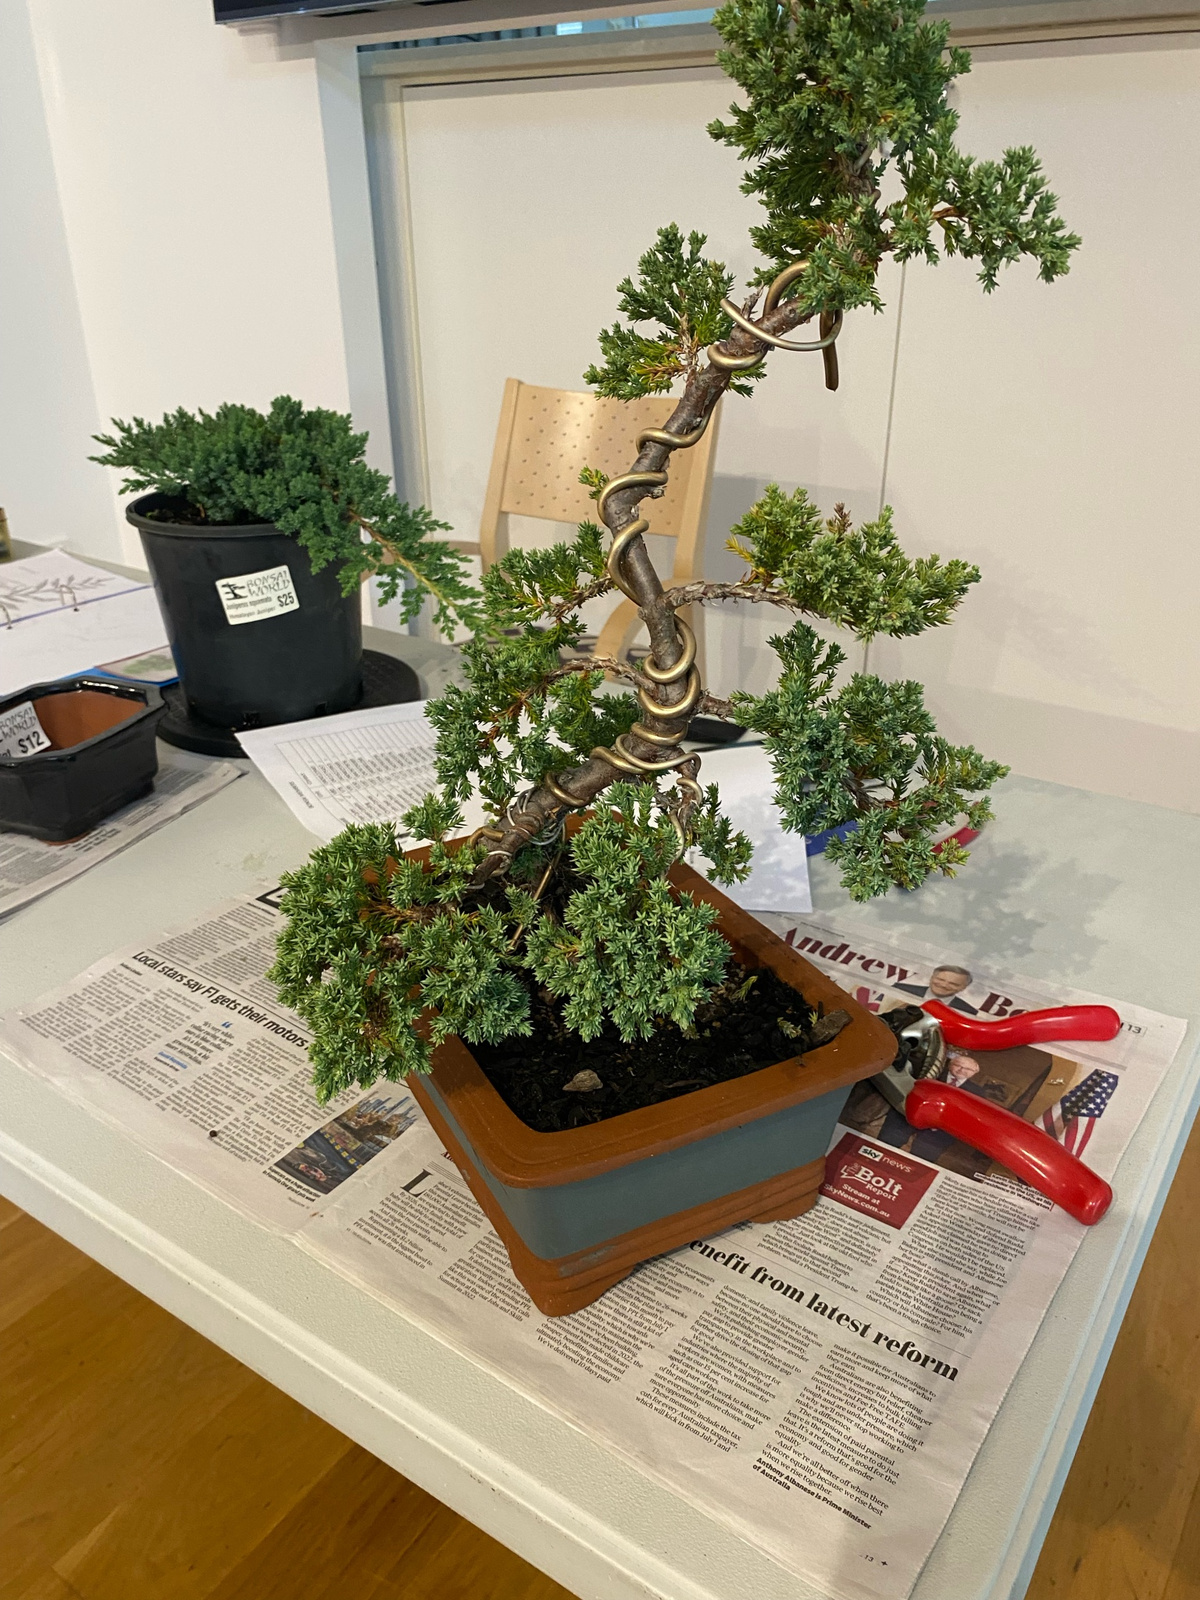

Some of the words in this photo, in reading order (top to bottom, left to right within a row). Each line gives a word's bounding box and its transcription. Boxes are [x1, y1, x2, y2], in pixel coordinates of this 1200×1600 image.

[247, 571, 287, 587] BONSAI
[248, 579, 290, 596] WORLD
[277, 592, 294, 607] $25
[1, 716, 36, 738] WORLD
[785, 927, 919, 982] Andrew
[132, 949, 165, 970] Local
[158, 964, 187, 983] stars
[182, 977, 205, 994] say
[200, 983, 220, 999] F1
[212, 993, 240, 1011] gets
[237, 1003, 266, 1025] their
[262, 1018, 308, 1049] motors
[1128, 1024, 1142, 1034] 13
[862, 1148, 880, 1158] sky
[882, 1158, 912, 1172] news
[842, 1184, 870, 1200] Stream
[855, 1166, 902, 1196] Bolt
[866, 1184, 896, 1201] Report
[824, 1184, 890, 1217] SkyNews.com.au
[687, 1238, 753, 1274] enefit
[749, 1263, 807, 1302] from
[806, 1290, 876, 1337] latest
[872, 1328, 960, 1383] reform
[868, 1289, 892, 1305] country
[878, 1285, 901, 1300] Which
[898, 1297, 912, 1306] will
[910, 1301, 940, 1319] Albanese
[864, 1293, 882, 1305] that's
[880, 1301, 898, 1313] been
[900, 1311, 922, 1325] tough
[919, 1321, 940, 1335] choice.
[536, 1328, 562, 1346] ultimately
[562, 1342, 586, 1361] boosting
[546, 1316, 580, 1339] Government
[588, 1342, 604, 1353] made
[603, 1351, 629, 1368] childcare
[562, 1334, 592, 1356] benefitting
[591, 1351, 613, 1367] families
[537, 1335, 554, 1348] We've
[553, 1345, 579, 1363] delivered
[584, 1364, 598, 1375] days
[597, 1373, 611, 1383] paid
[634, 1396, 655, 1409] which
[652, 1406, 666, 1416] will
[663, 1411, 680, 1423] kick
[683, 1422, 700, 1436] from
[699, 1431, 714, 1444] July
[638, 1390, 653, 1400] cuts
[660, 1402, 678, 1416] every
[676, 1409, 710, 1432] Australian
[760, 1449, 780, 1463] when
[789, 1467, 803, 1477] rise
[760, 1468, 791, 1489] Australia
[791, 1449, 810, 1462] we're
[818, 1464, 839, 1480] better
[848, 1483, 869, 1498] when
[868, 1494, 888, 1509] there
[756, 1456, 785, 1478] Anthony
[783, 1473, 815, 1495] Albanese
[821, 1496, 842, 1511] Prime
[841, 1508, 871, 1528] Minister
[771, 1446, 790, 1459] more
[789, 1457, 817, 1477] equality
[816, 1472, 844, 1492] because
[853, 1496, 868, 1506] rise
[867, 1502, 884, 1515] best
